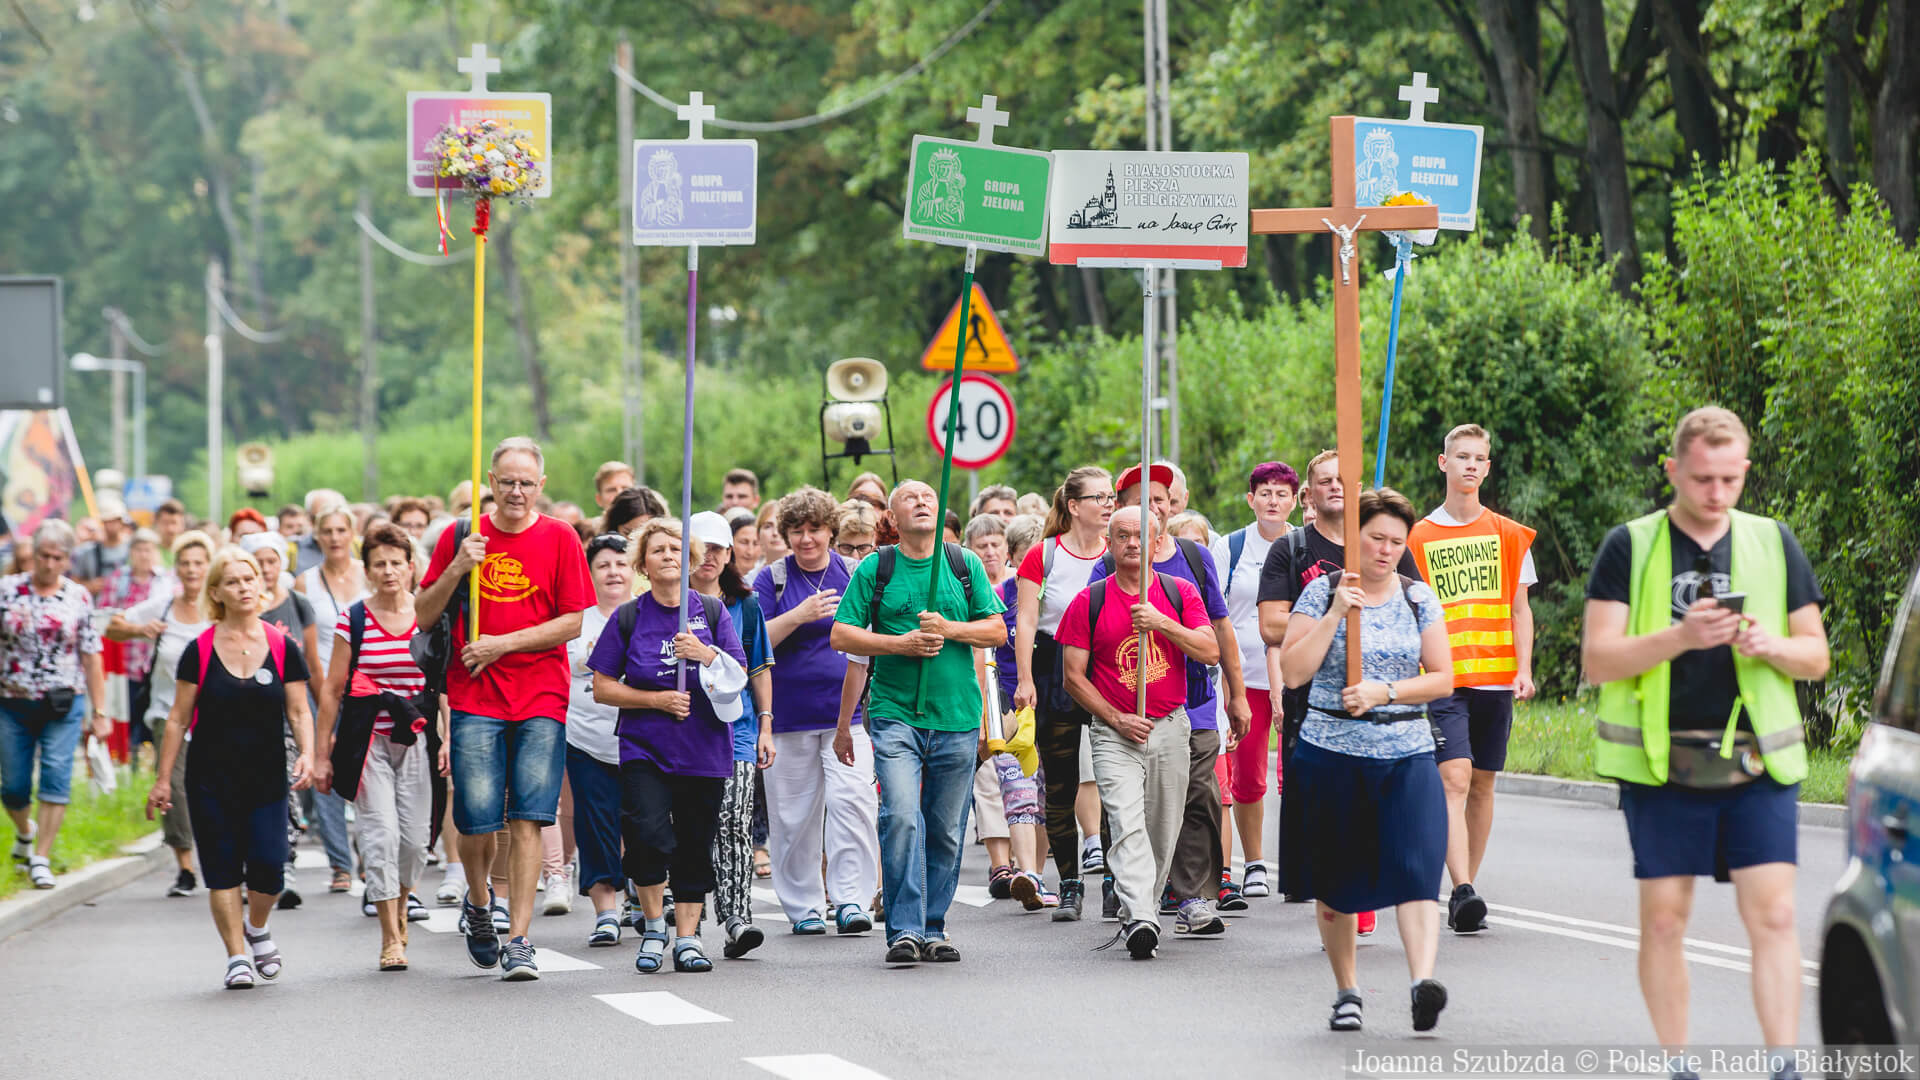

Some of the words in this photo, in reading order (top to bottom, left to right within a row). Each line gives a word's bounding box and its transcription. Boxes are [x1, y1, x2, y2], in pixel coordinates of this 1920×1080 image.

[1412, 155, 1446, 168] GRUPA
[1124, 163, 1234, 178] BIAŁOSTOCKA
[690, 175, 723, 186] GRUPA
[984, 179, 1020, 195] GRUPA
[1124, 178, 1180, 192] PIESZA
[690, 190, 744, 203] FIOLETOWA
[982, 195, 1024, 212] ZIELONA
[1124, 192, 1237, 208] PIELGRZYMKA
[1137, 220, 1159, 229] na
[942, 401, 1001, 442] 40
[1429, 541, 1498, 571] KIEROWANIE
[1435, 565, 1498, 599] RUCHEM
